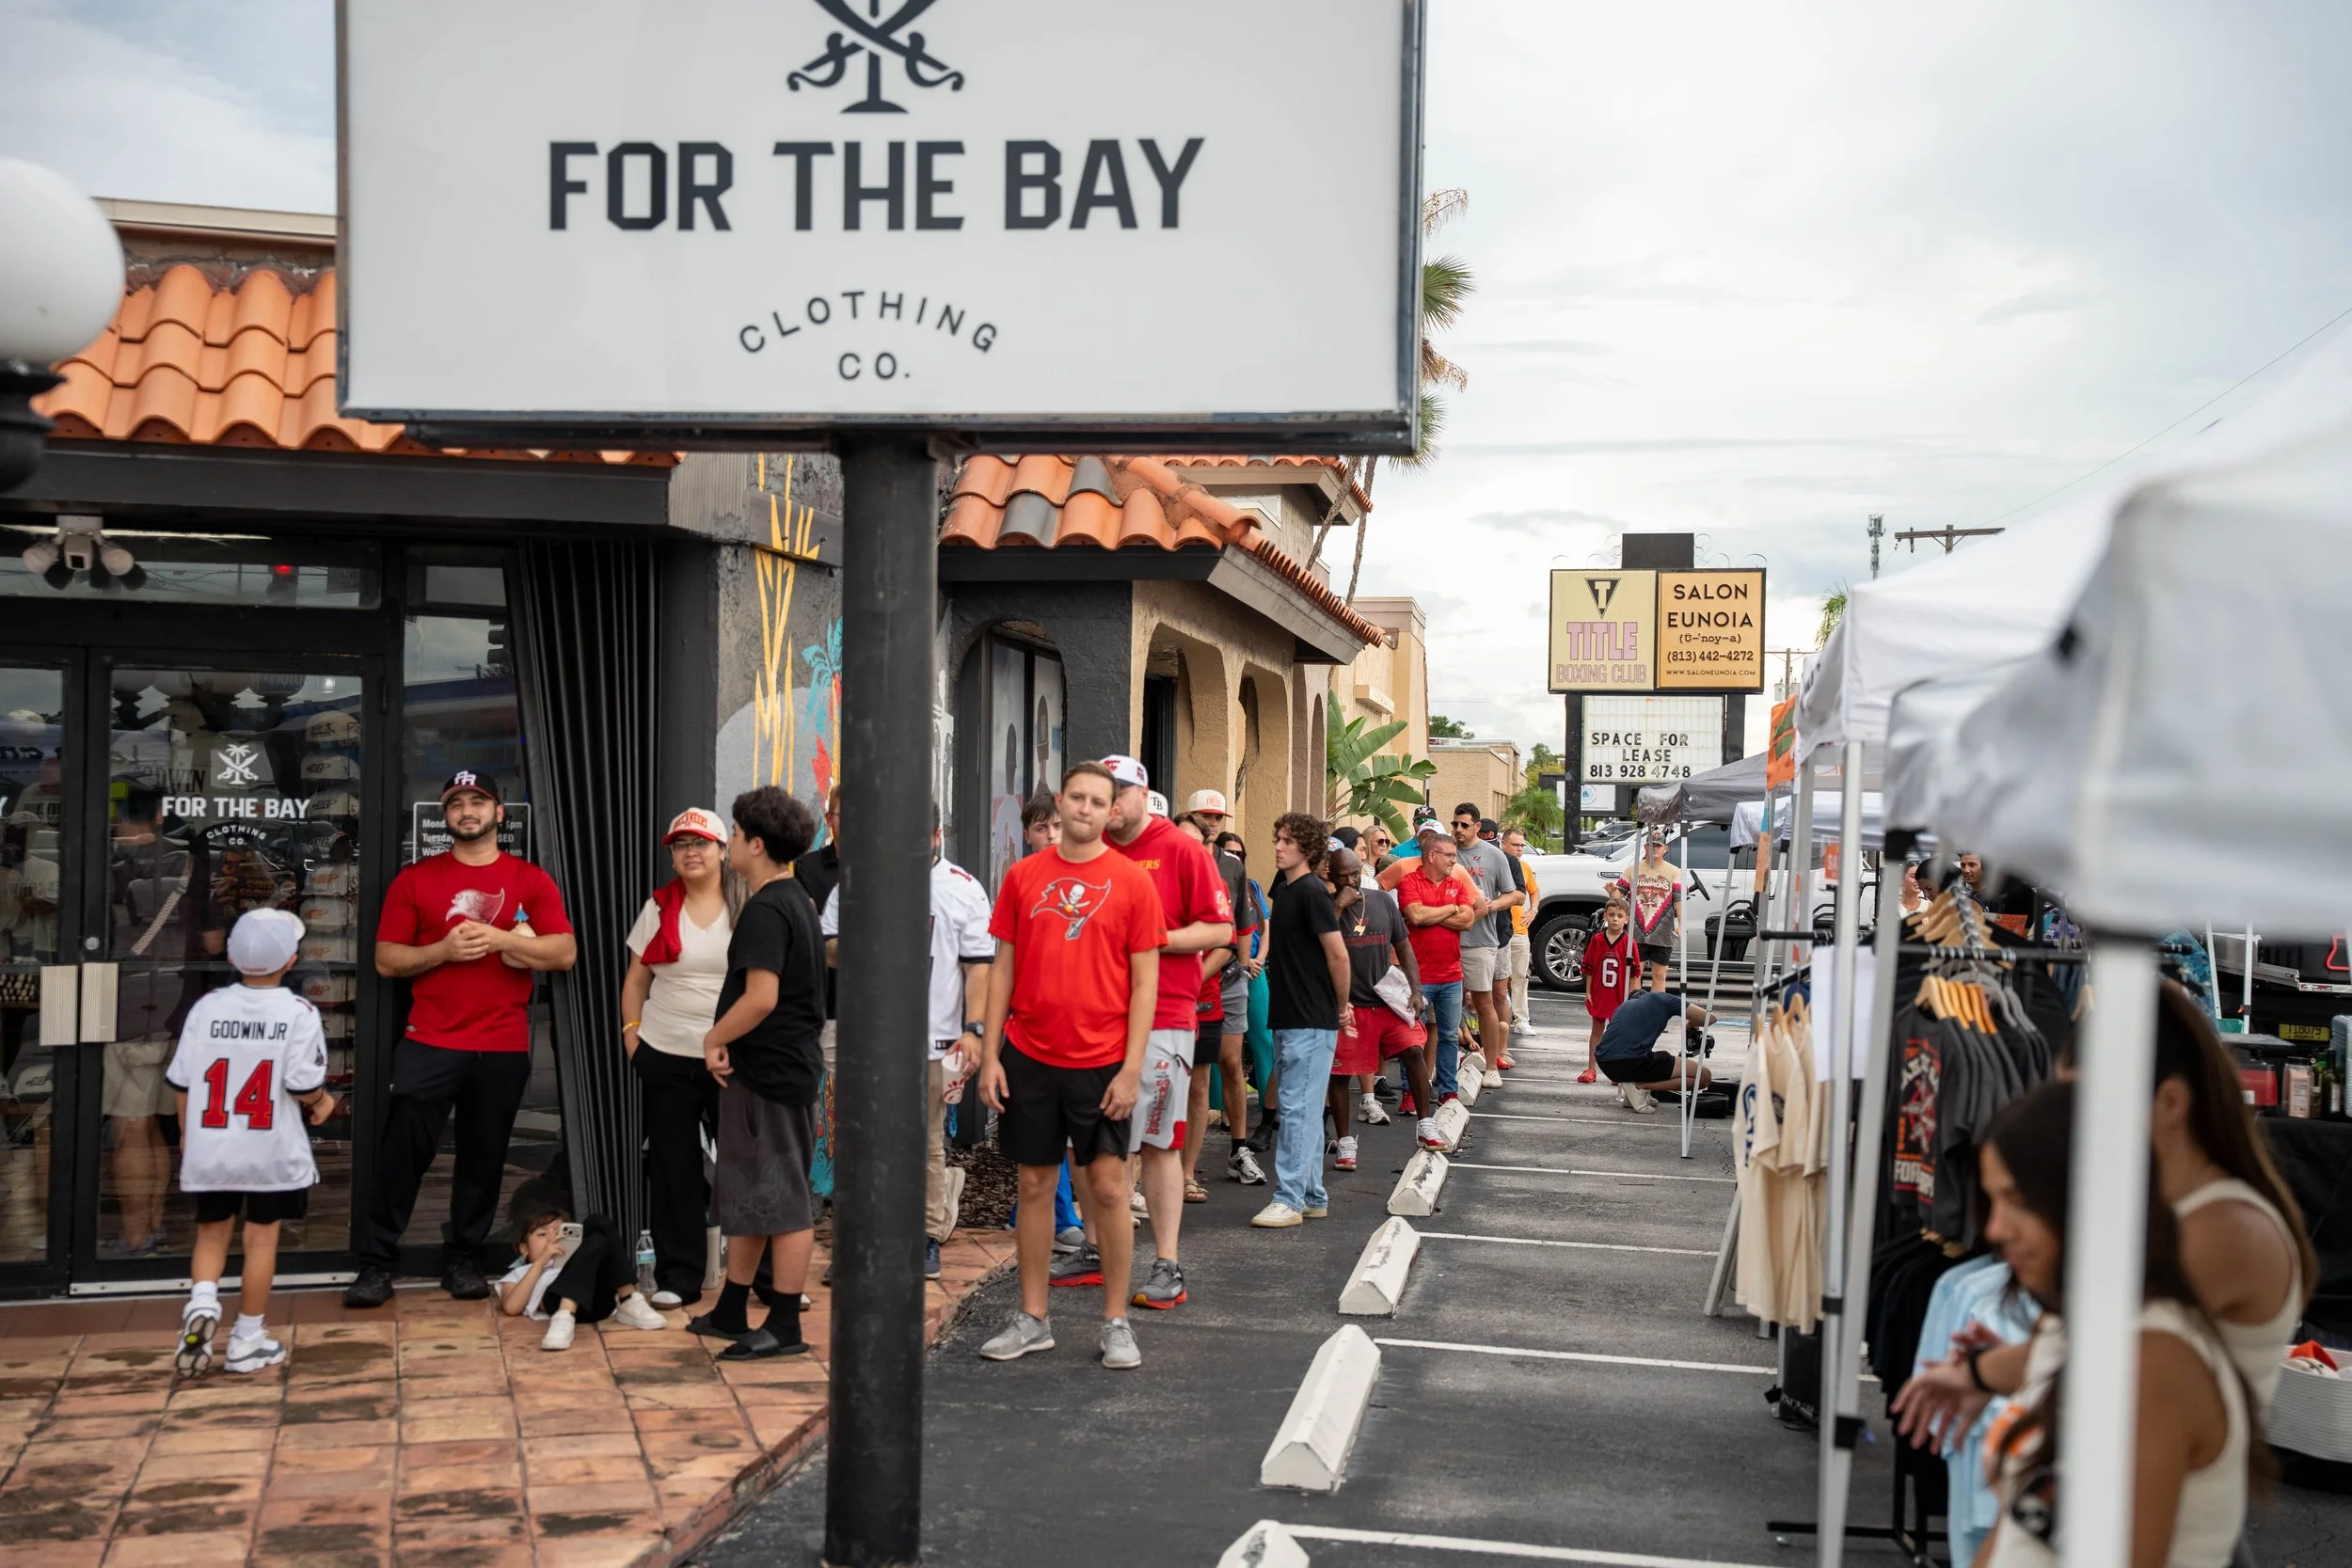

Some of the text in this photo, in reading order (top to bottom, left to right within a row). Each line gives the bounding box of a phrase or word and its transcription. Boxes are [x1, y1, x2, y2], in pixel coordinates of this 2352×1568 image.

[548, 137, 1206, 230] FOR THE BAY
[739, 291, 999, 354] CLOTHING
[837, 352, 912, 380] CO.
[1674, 584, 1748, 600] SALON
[1667, 612, 1754, 627] EUNOIA
[1566, 622, 1638, 660] TITLE
[1667, 651, 1754, 663] (813) 442-4272
[1556, 664, 1646, 684] BOXING CLUB
[1592, 733, 1688, 746] SPACE FOR
[1622, 750, 1671, 762] LEASE
[1590, 765, 1691, 778] 813 928 4748
[162, 797, 206, 817] FOR
[214, 798, 259, 818] THE
[264, 799, 310, 818] BAY
[1151, 797, 1163, 811] TB
[206, 825, 267, 840] CLOTHING
[1602, 958, 1618, 988] 6
[210, 1021, 288, 1040] GODWIN JR
[201, 1057, 274, 1130] 14
